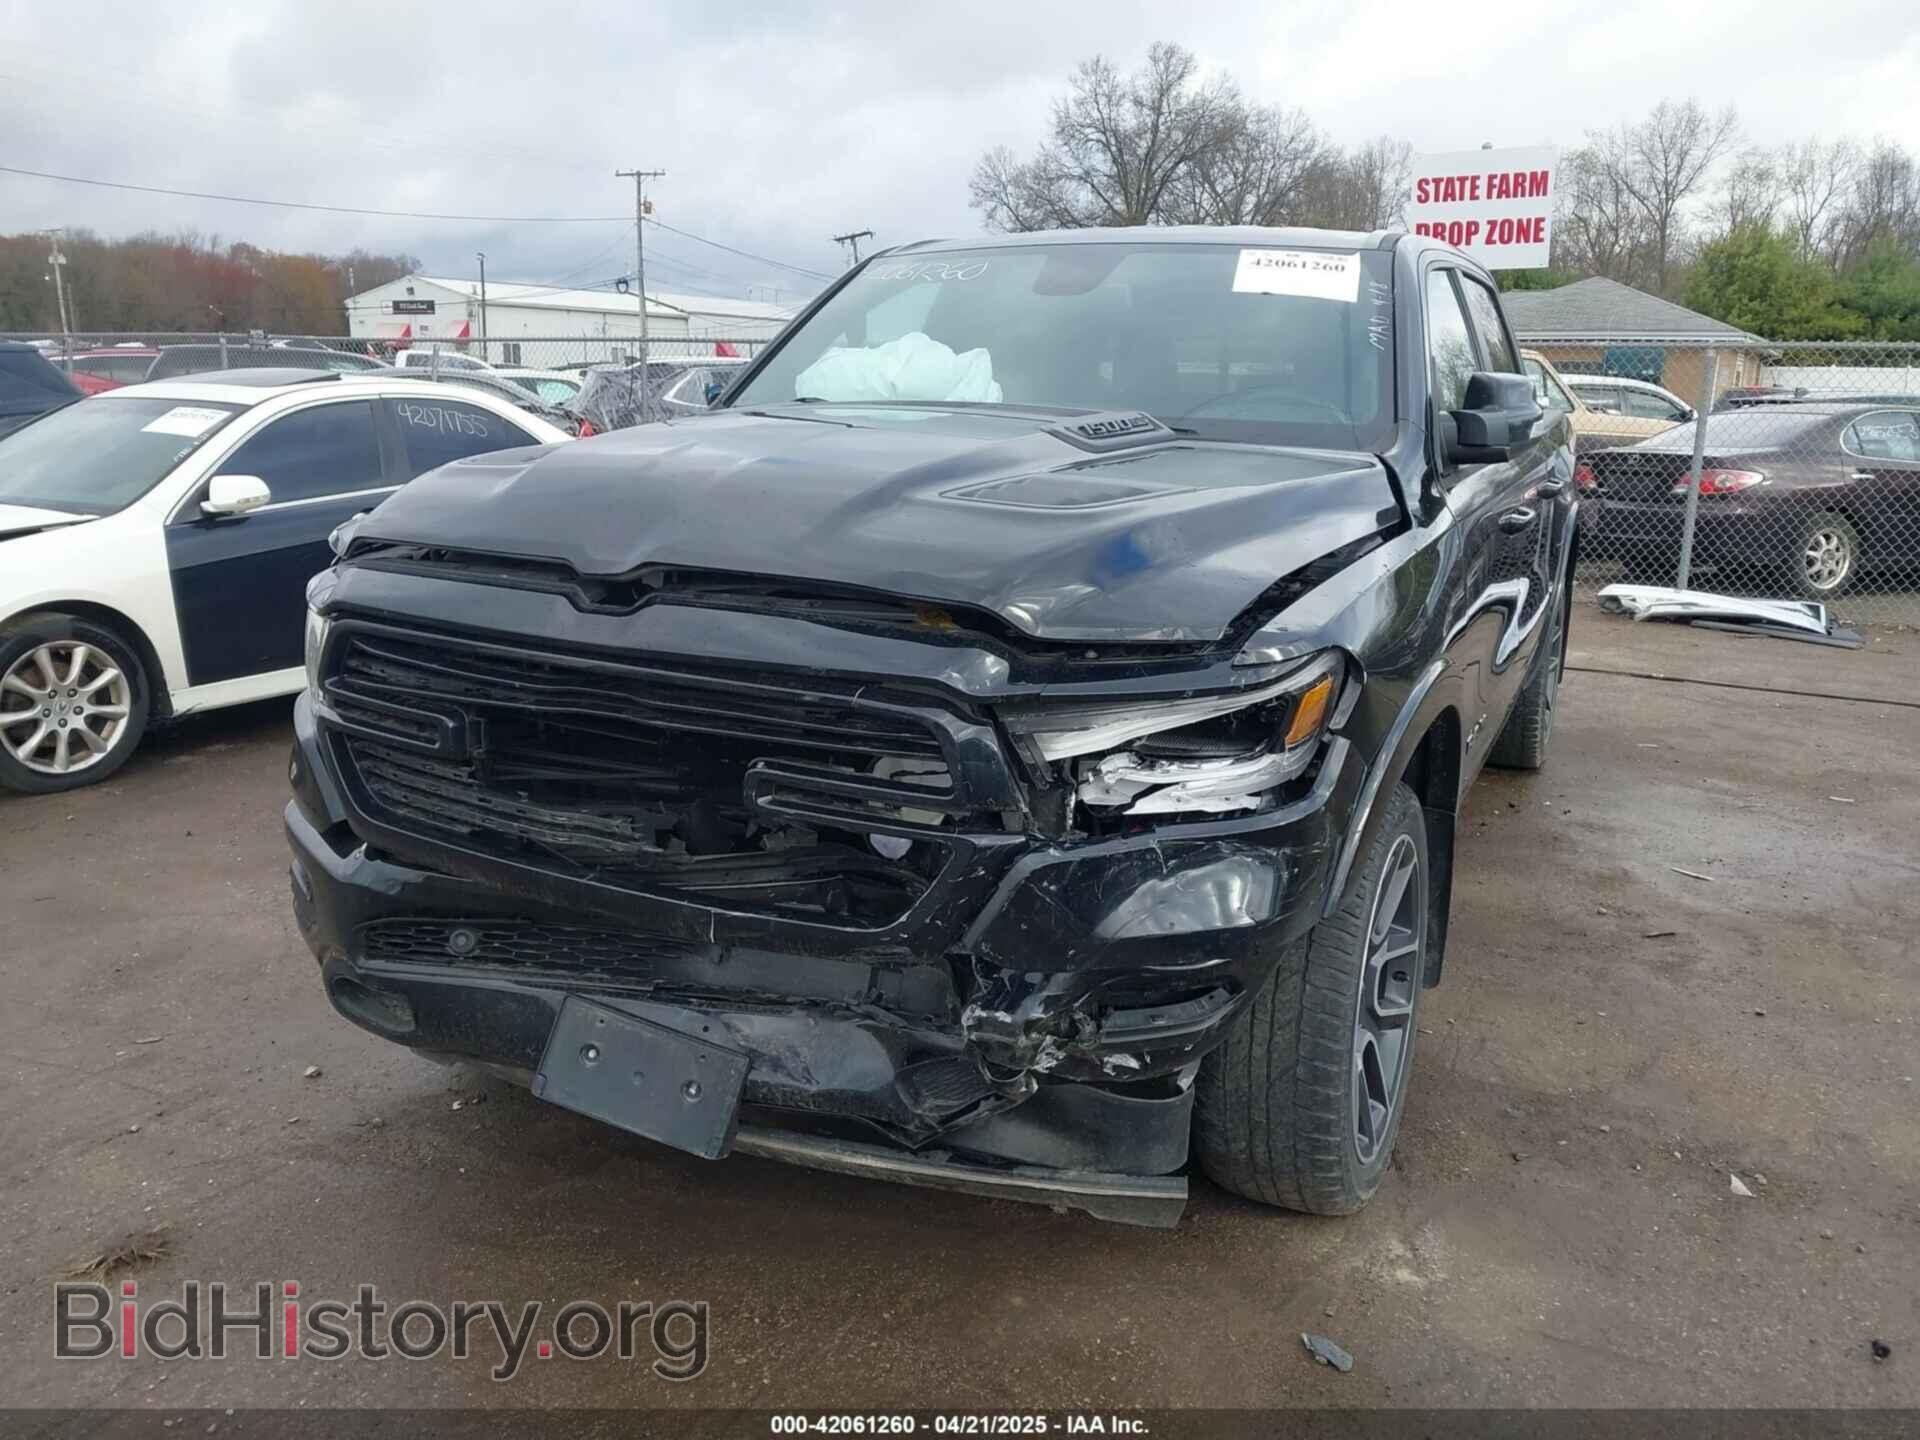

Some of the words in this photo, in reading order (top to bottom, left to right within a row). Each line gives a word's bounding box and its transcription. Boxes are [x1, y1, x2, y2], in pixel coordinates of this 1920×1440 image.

[1416, 175, 1480, 204] STATE
[1486, 170, 1549, 200] FARM
[1485, 217, 1546, 245] ZONE
[1250, 258, 1346, 273] 42061260
[398, 401, 488, 437] 42071755
